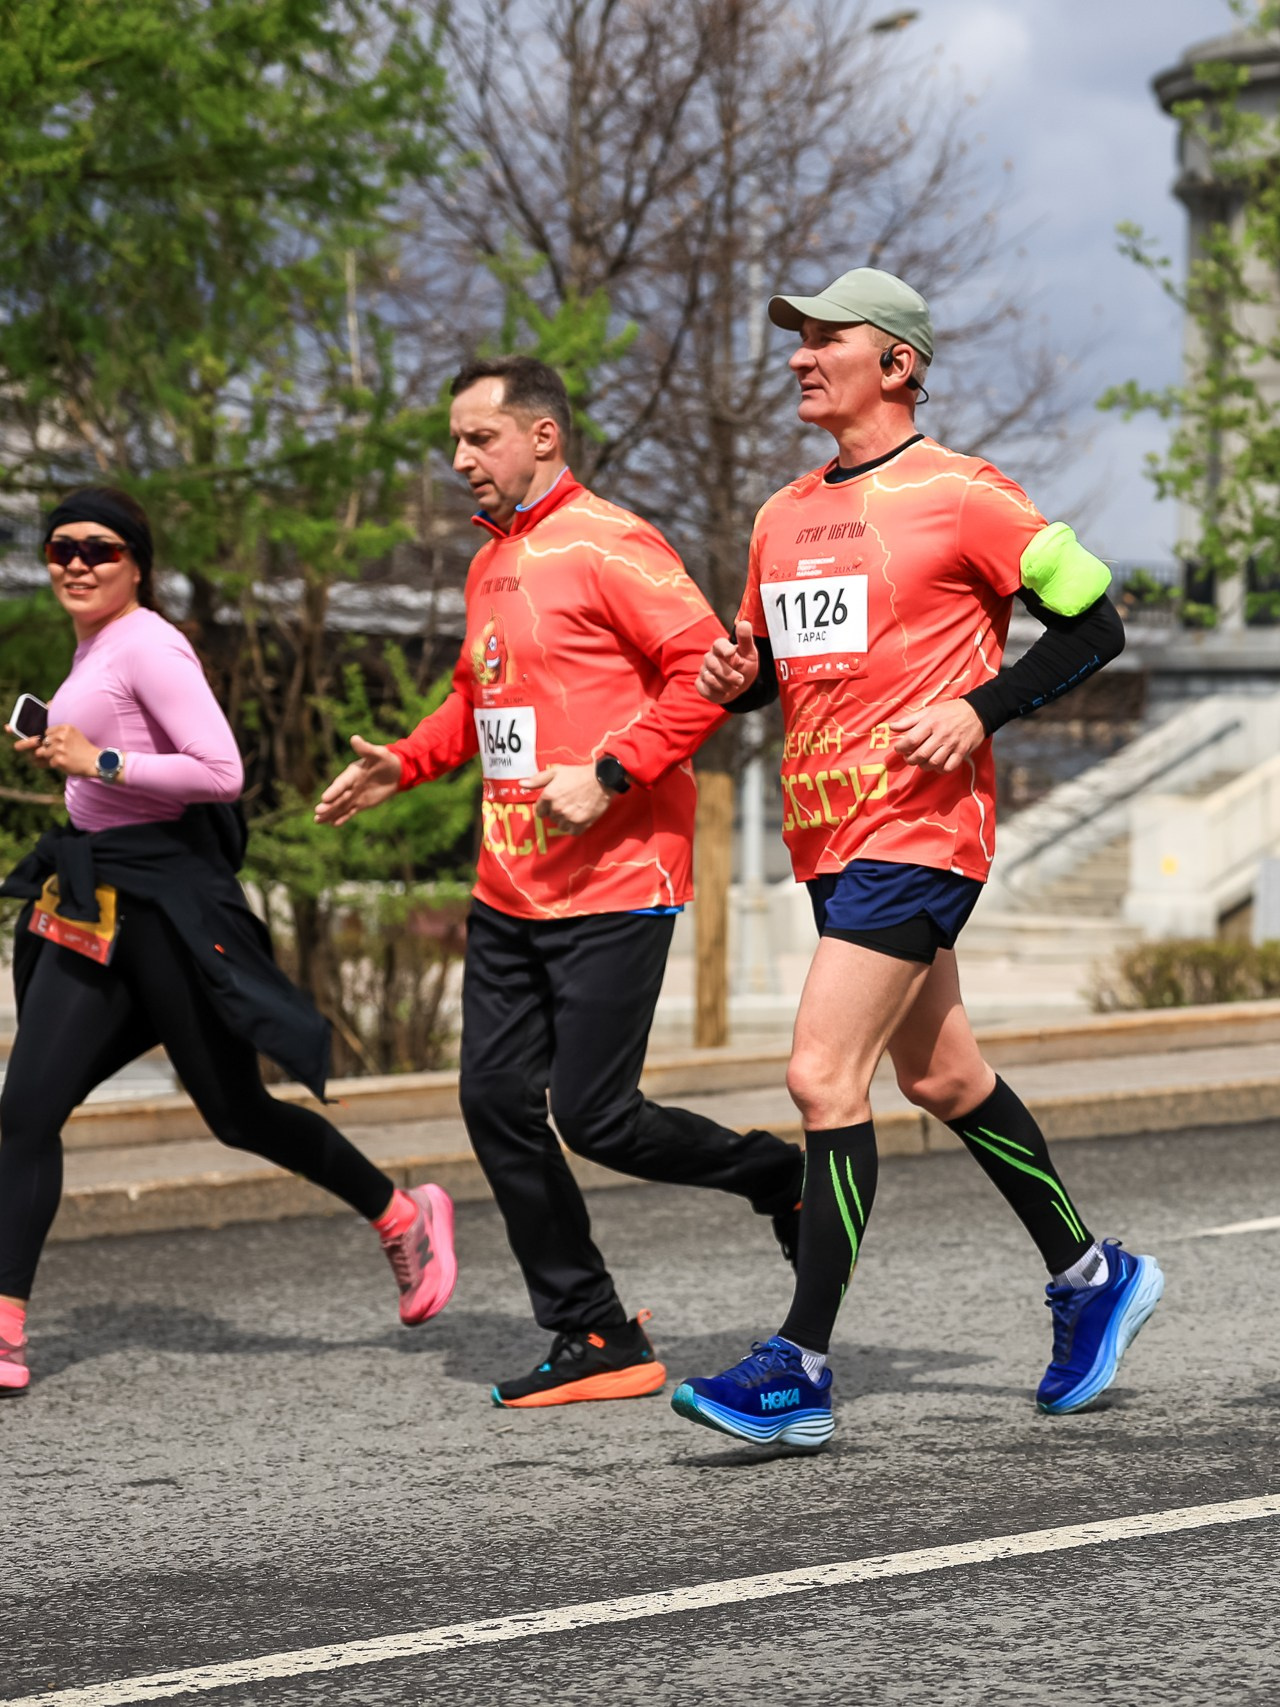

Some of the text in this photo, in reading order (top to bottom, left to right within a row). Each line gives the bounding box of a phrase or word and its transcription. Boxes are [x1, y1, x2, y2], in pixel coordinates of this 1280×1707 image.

[776, 588, 849, 631] 1126
[797, 631, 827, 643] ТАРАС
[760, 1388, 800, 1410] HOKA
